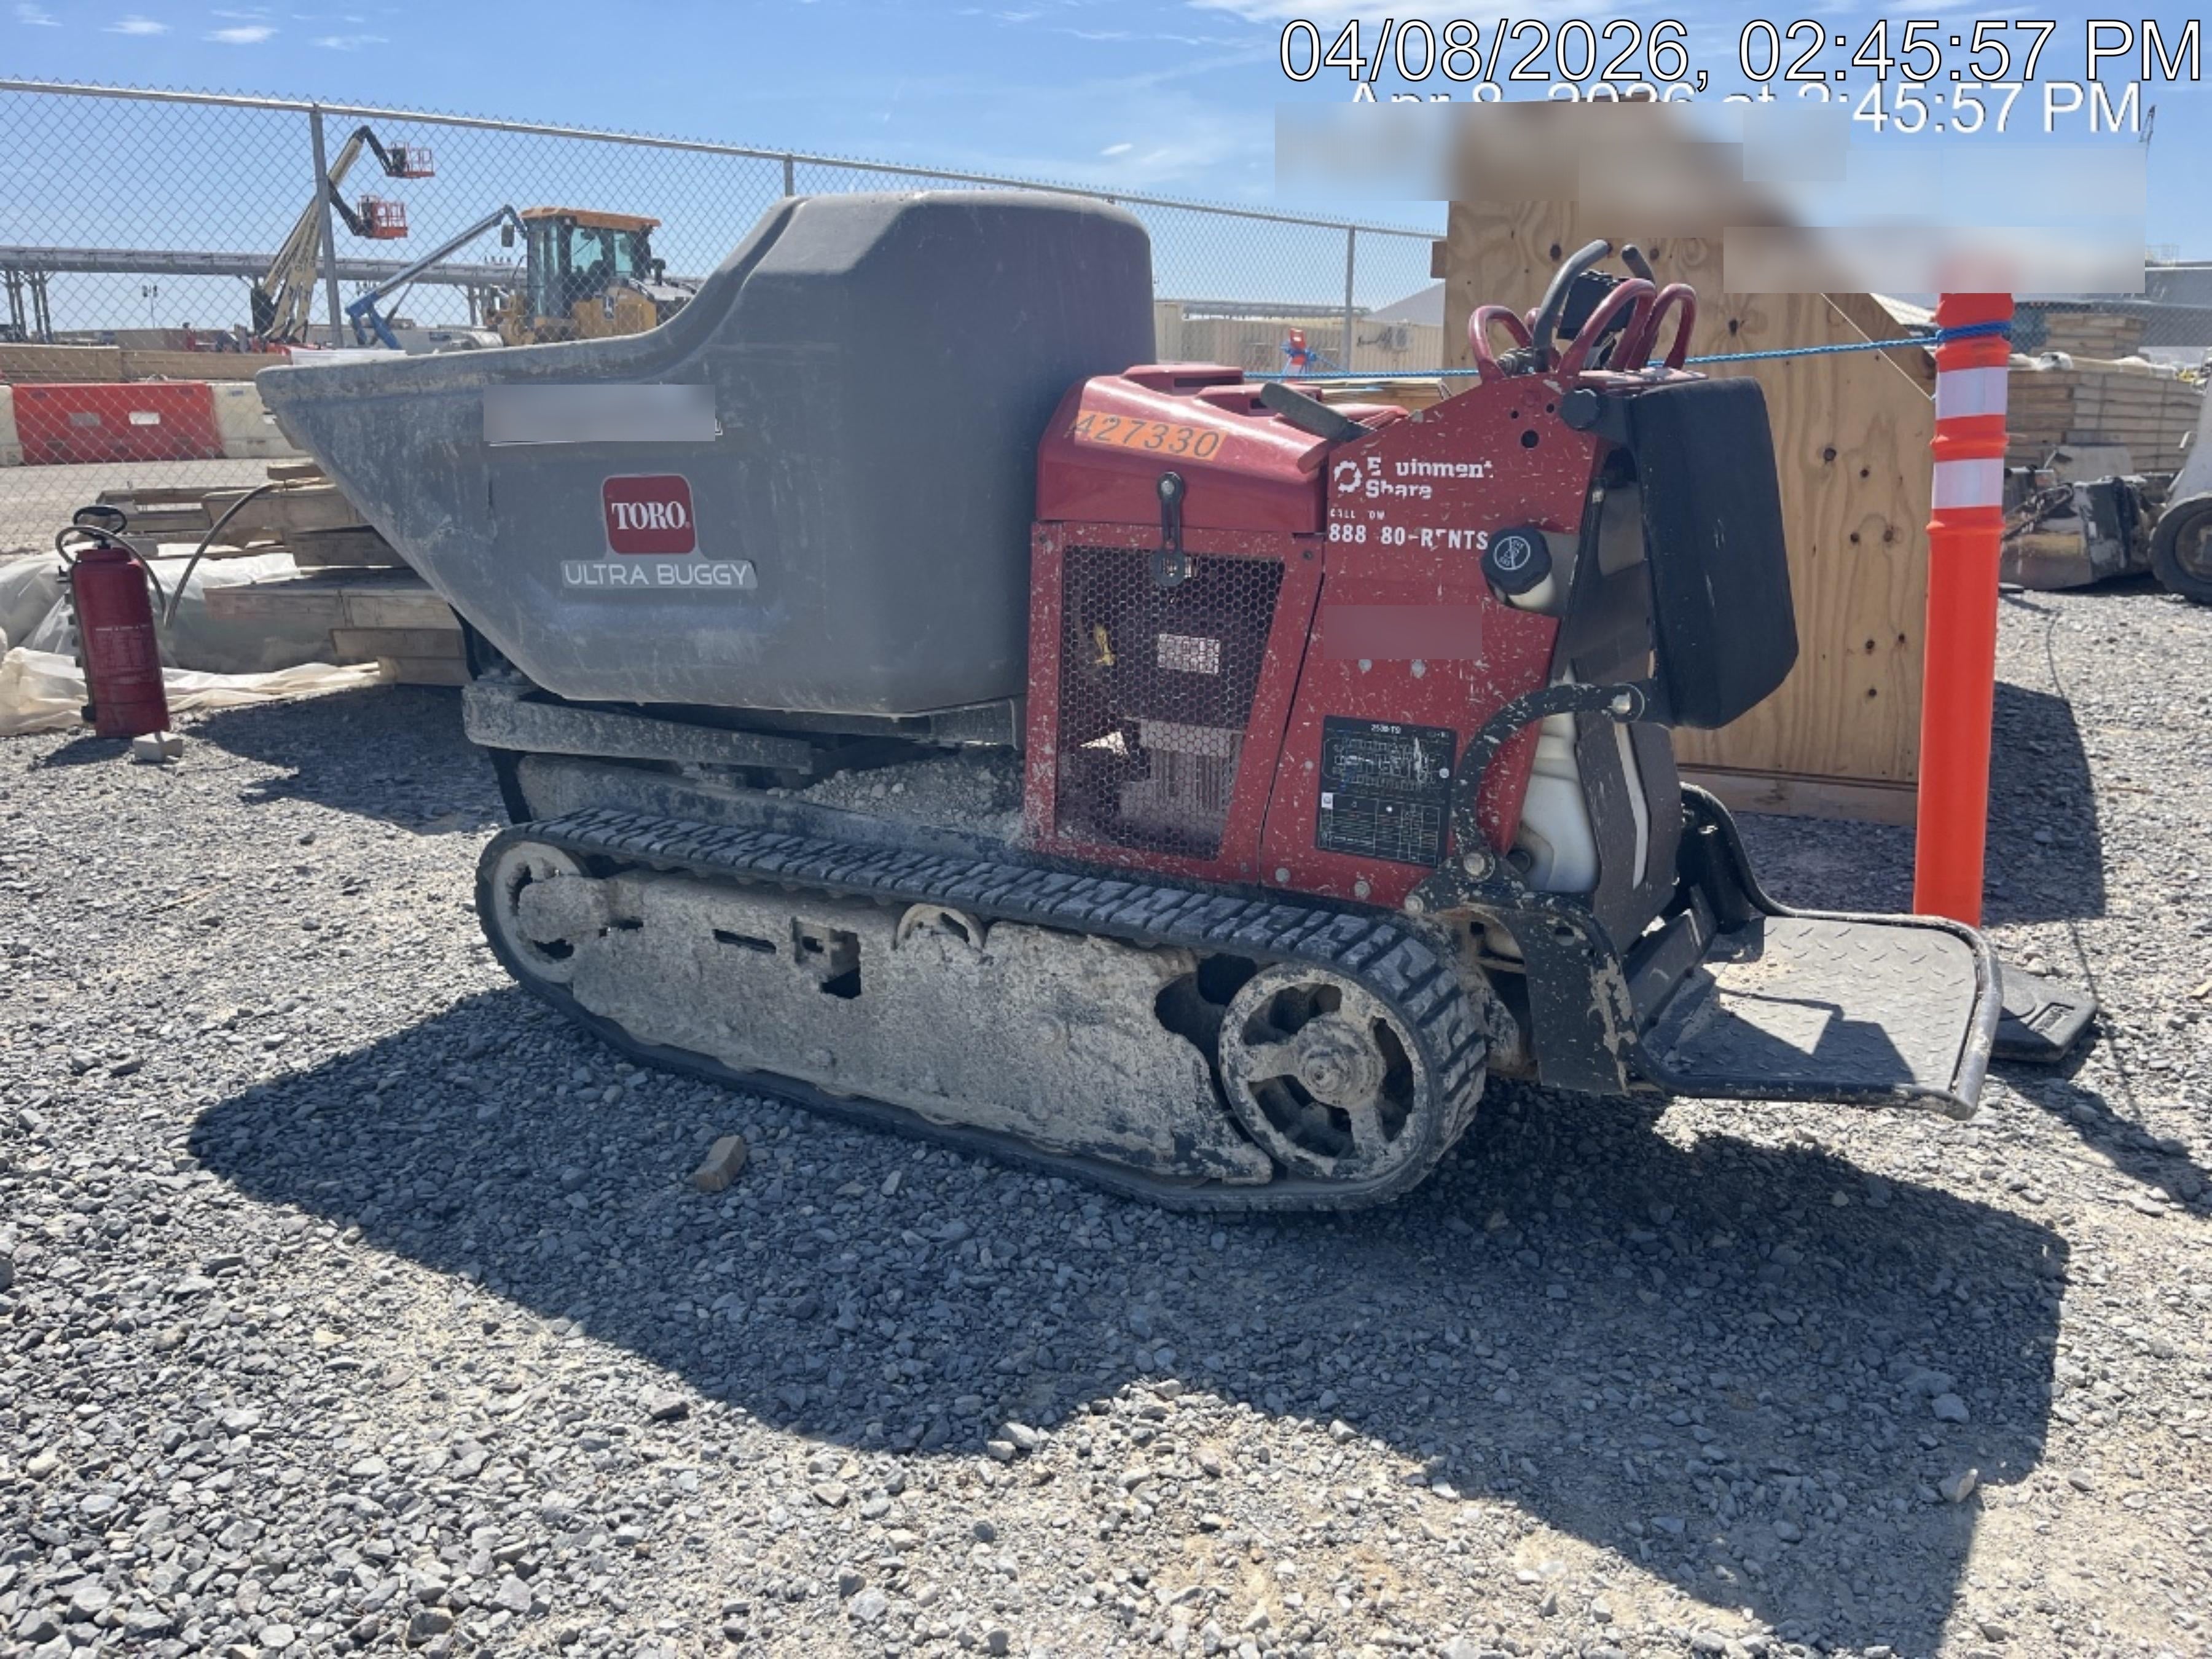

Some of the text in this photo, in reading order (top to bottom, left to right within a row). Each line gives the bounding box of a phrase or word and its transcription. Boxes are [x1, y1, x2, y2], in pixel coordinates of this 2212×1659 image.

[1064, 414, 1219, 458] 427330
[1367, 457, 1494, 479] Euiment
[611, 501, 686, 530] TORO
[1367, 510, 1385, 520] OW
[565, 565, 748, 586] ULTRA BUGGY
